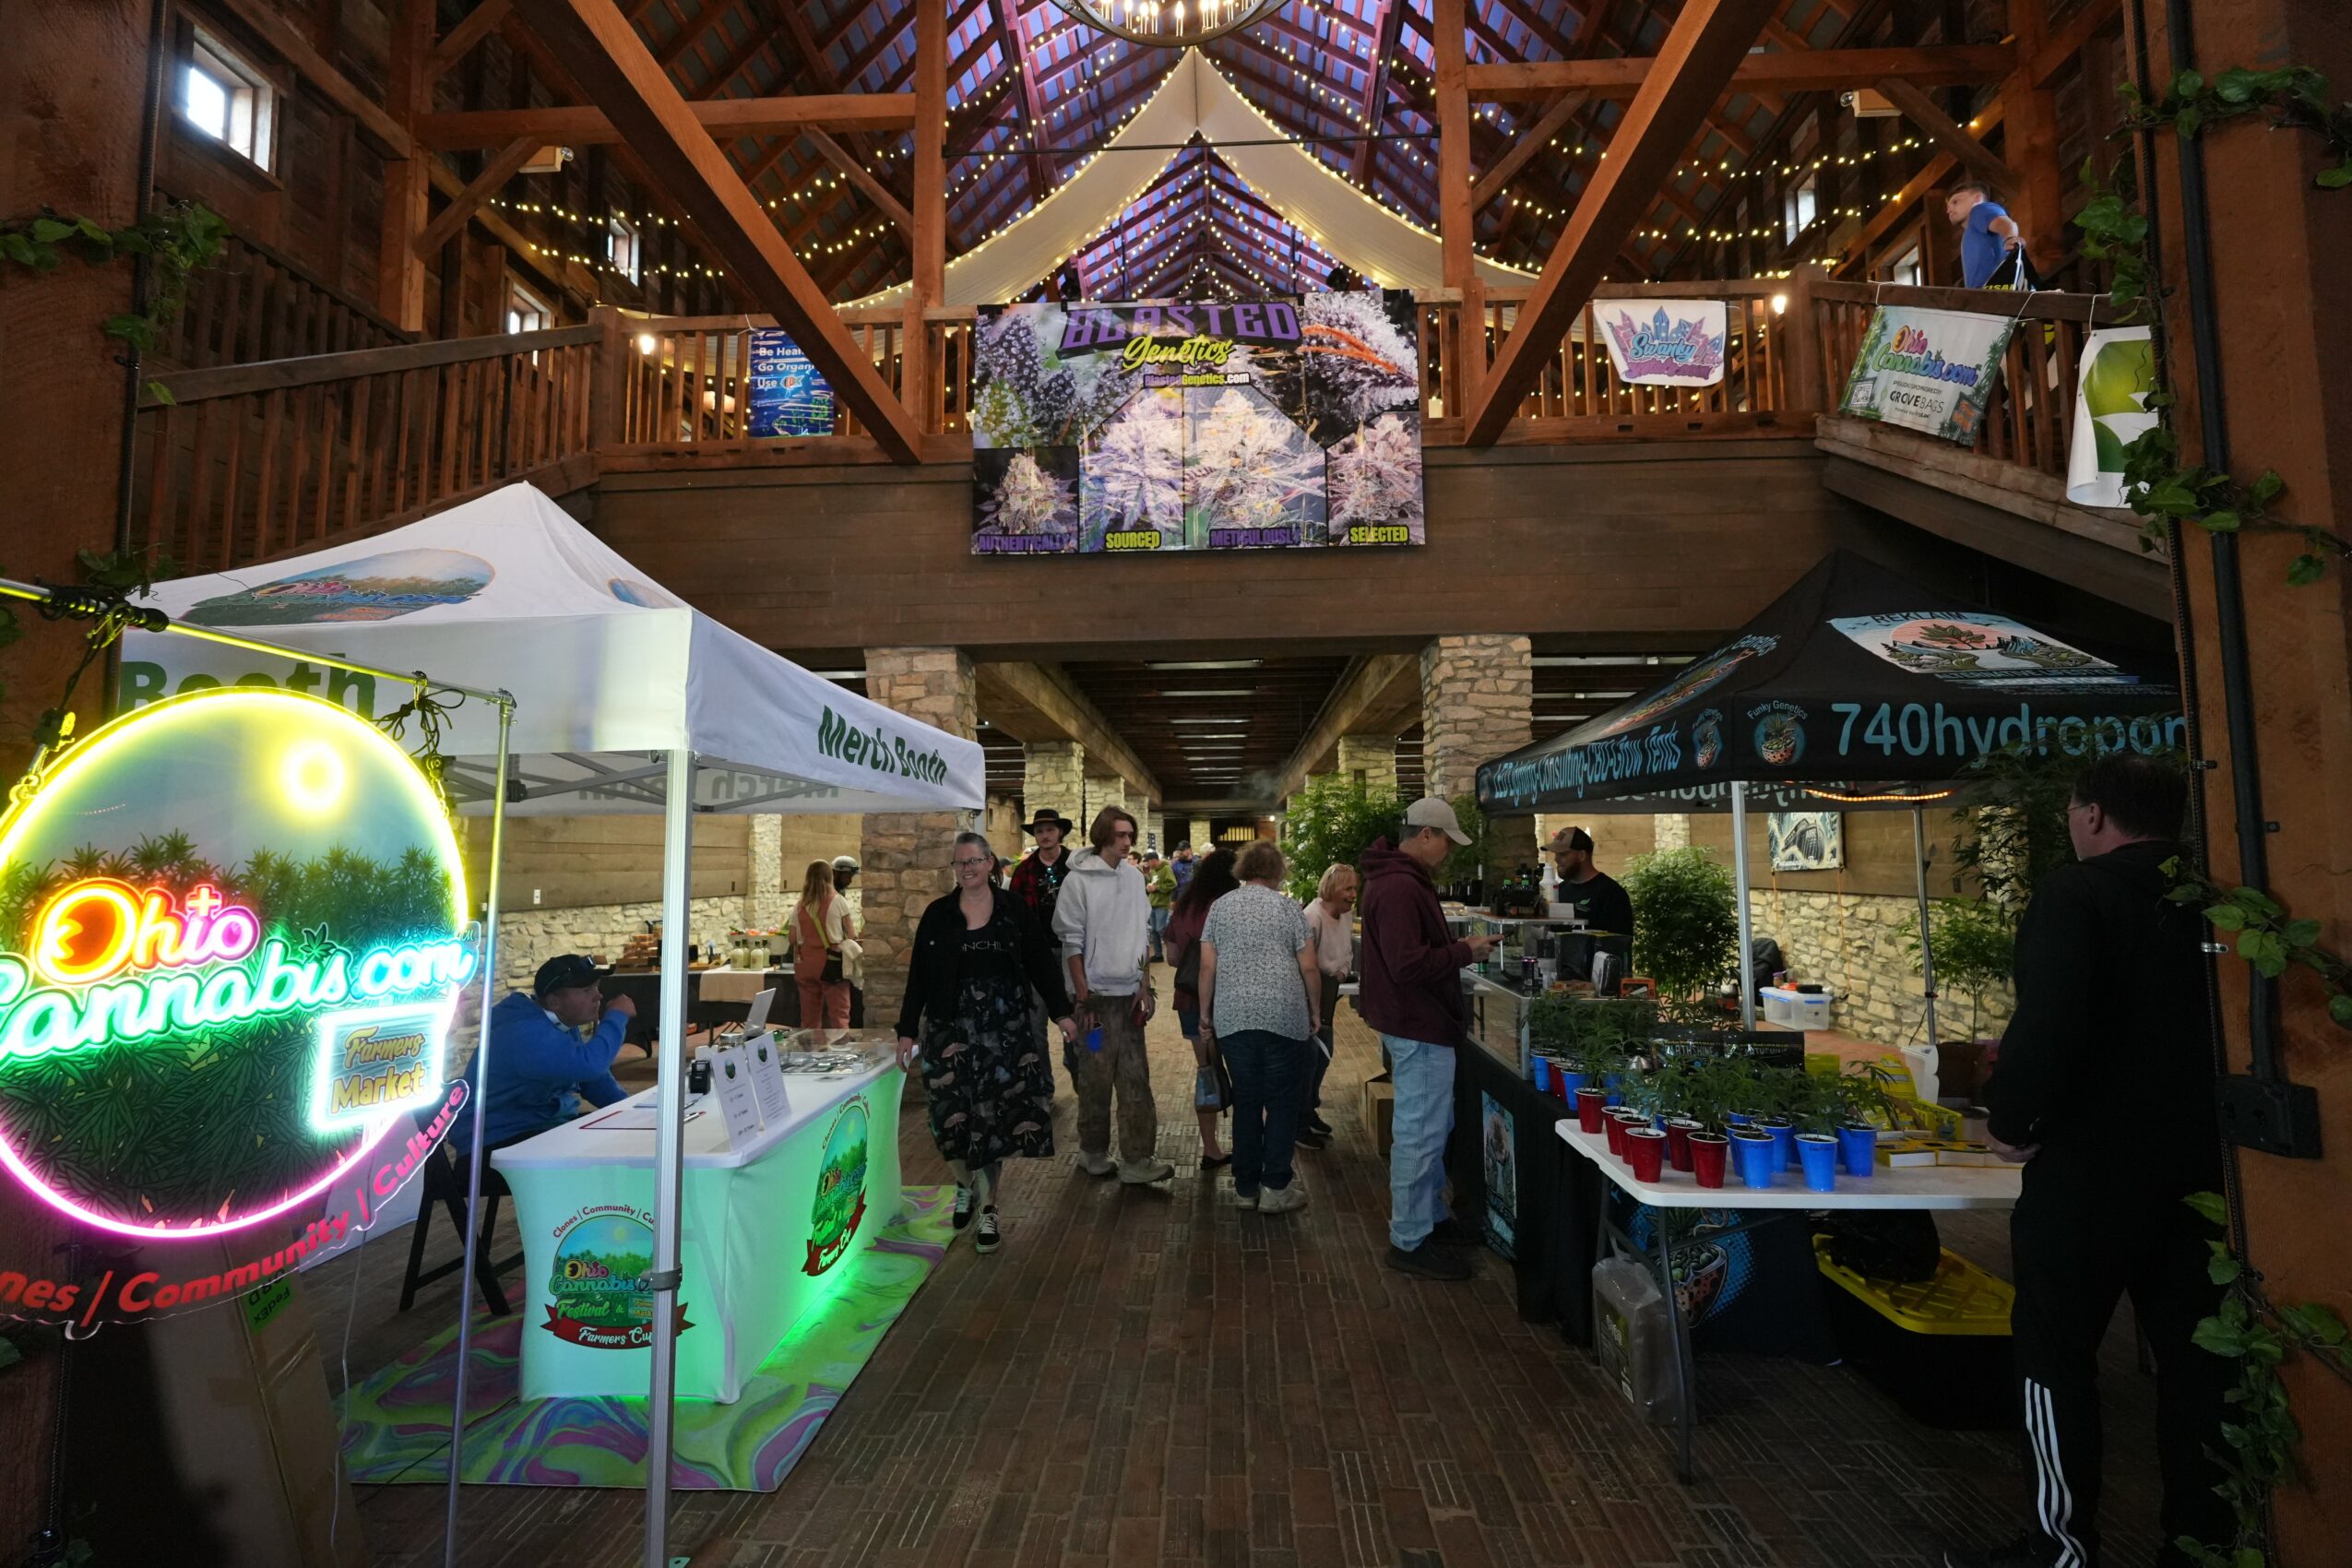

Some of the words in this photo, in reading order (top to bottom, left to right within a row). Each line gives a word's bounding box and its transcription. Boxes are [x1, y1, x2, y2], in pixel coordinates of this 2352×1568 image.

[1061, 303, 1301, 349] BLASTED
[1630, 333, 1696, 362] Swanky
[1892, 325, 1928, 354] Ohio
[759, 347, 774, 356] Be
[758, 362, 774, 372] Go
[1872, 342, 1978, 386] Cannabis.com
[757, 378, 777, 387] Use
[1145, 372, 1250, 386] BlastedGenetics.com
[978, 534, 1072, 552] AUTHENTICALLY
[1106, 531, 1160, 549] SOURCED
[1210, 529, 1301, 546] METICULOUSLY
[1349, 526, 1408, 542] SELECTED
[1871, 612, 1968, 625] REKLAIM
[1746, 703, 1771, 719] Funky
[1772, 700, 1808, 719] Genetics
[818, 705, 895, 773] Merch
[895, 736, 947, 786] Booth
[36, 881, 258, 983] Ohio
[344, 1028, 426, 1071] Farmers
[331, 1063, 426, 1115] Market
[117, 1209, 350, 1312] Community
[372, 1085, 464, 1197] Culture
[552, 1215, 578, 1238] Clones
[582, 1204, 636, 1216] Community
[564, 1258, 610, 1280] Ohio
[556, 1298, 611, 1320] Festival
[615, 1304, 625, 1314] &
[578, 1326, 627, 1346] Farmers
